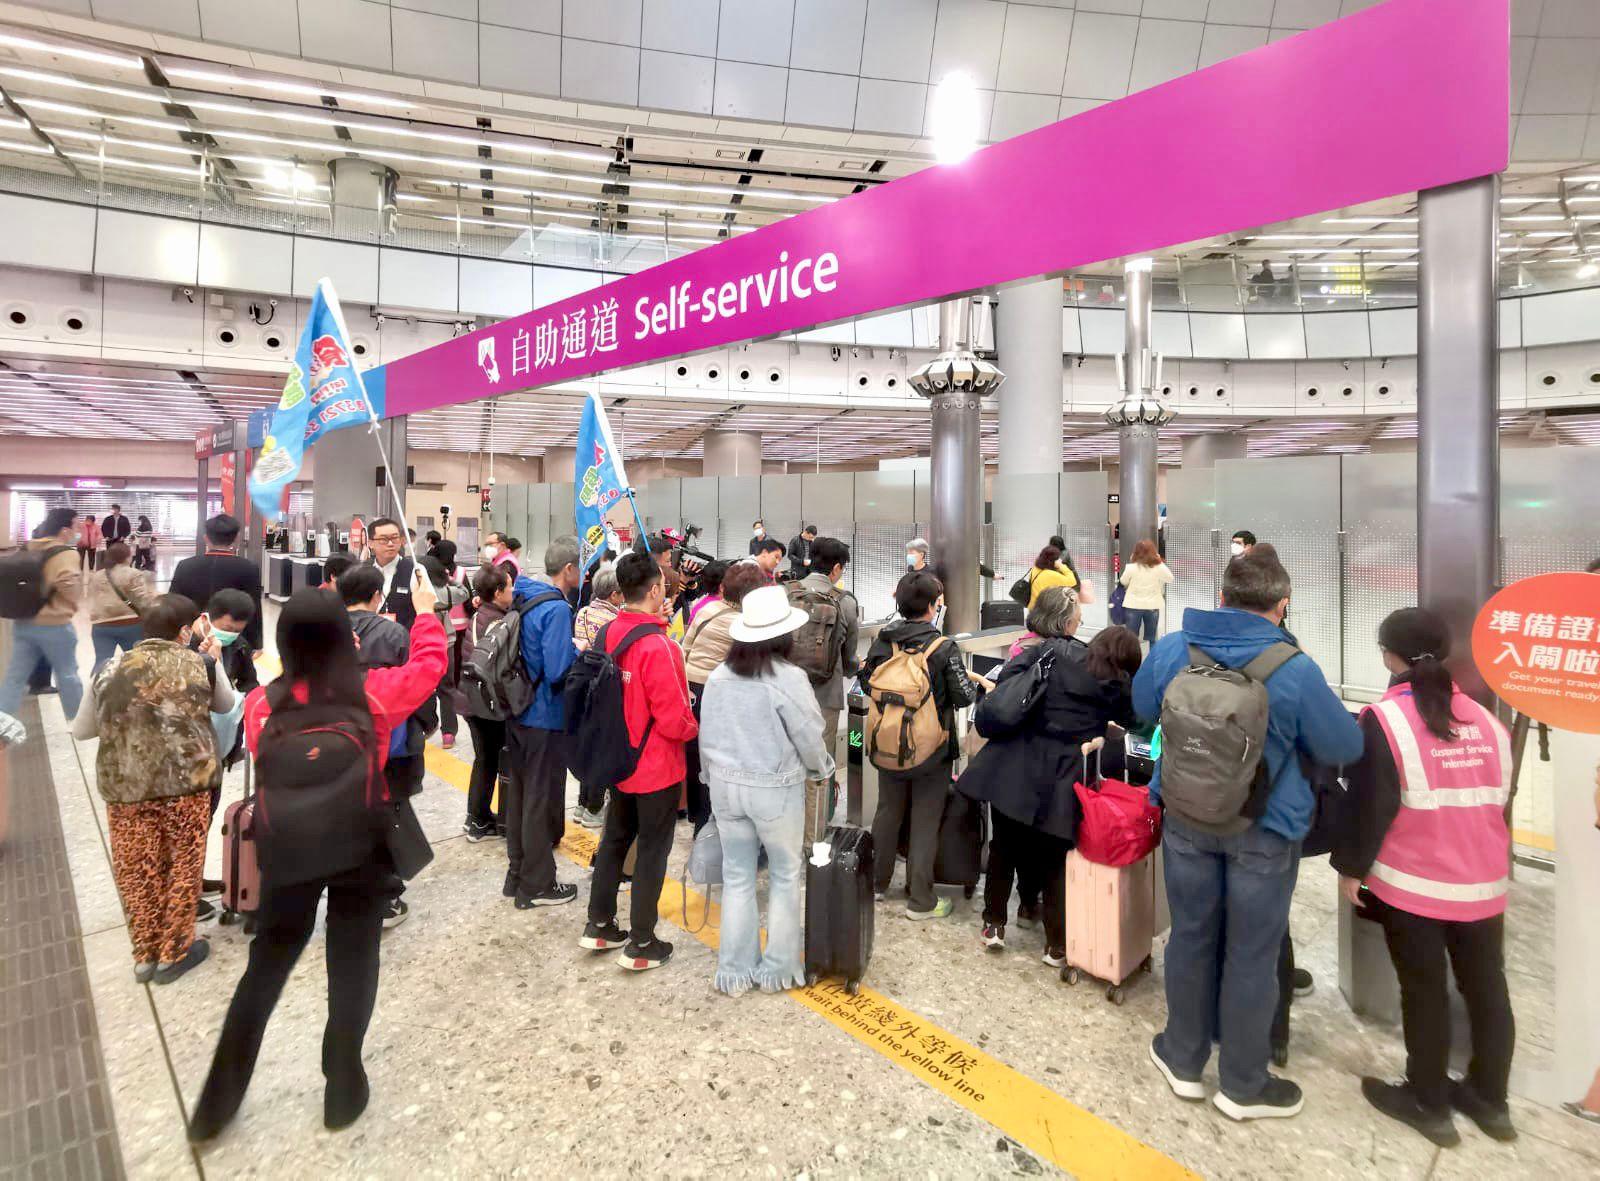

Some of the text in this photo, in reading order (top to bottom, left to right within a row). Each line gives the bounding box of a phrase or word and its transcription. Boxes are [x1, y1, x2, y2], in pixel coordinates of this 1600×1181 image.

[511, 251, 839, 377] 自助通道 Self-service
[1488, 610, 1600, 642] 準備證
[1509, 671, 1532, 681] Get
[1535, 675, 1563, 685] your
[1501, 682, 1562, 697] document
[1431, 745, 1494, 758] Customer Service
[1441, 757, 1484, 769] Information
[804, 989, 986, 1103] wait behind the yellow line
